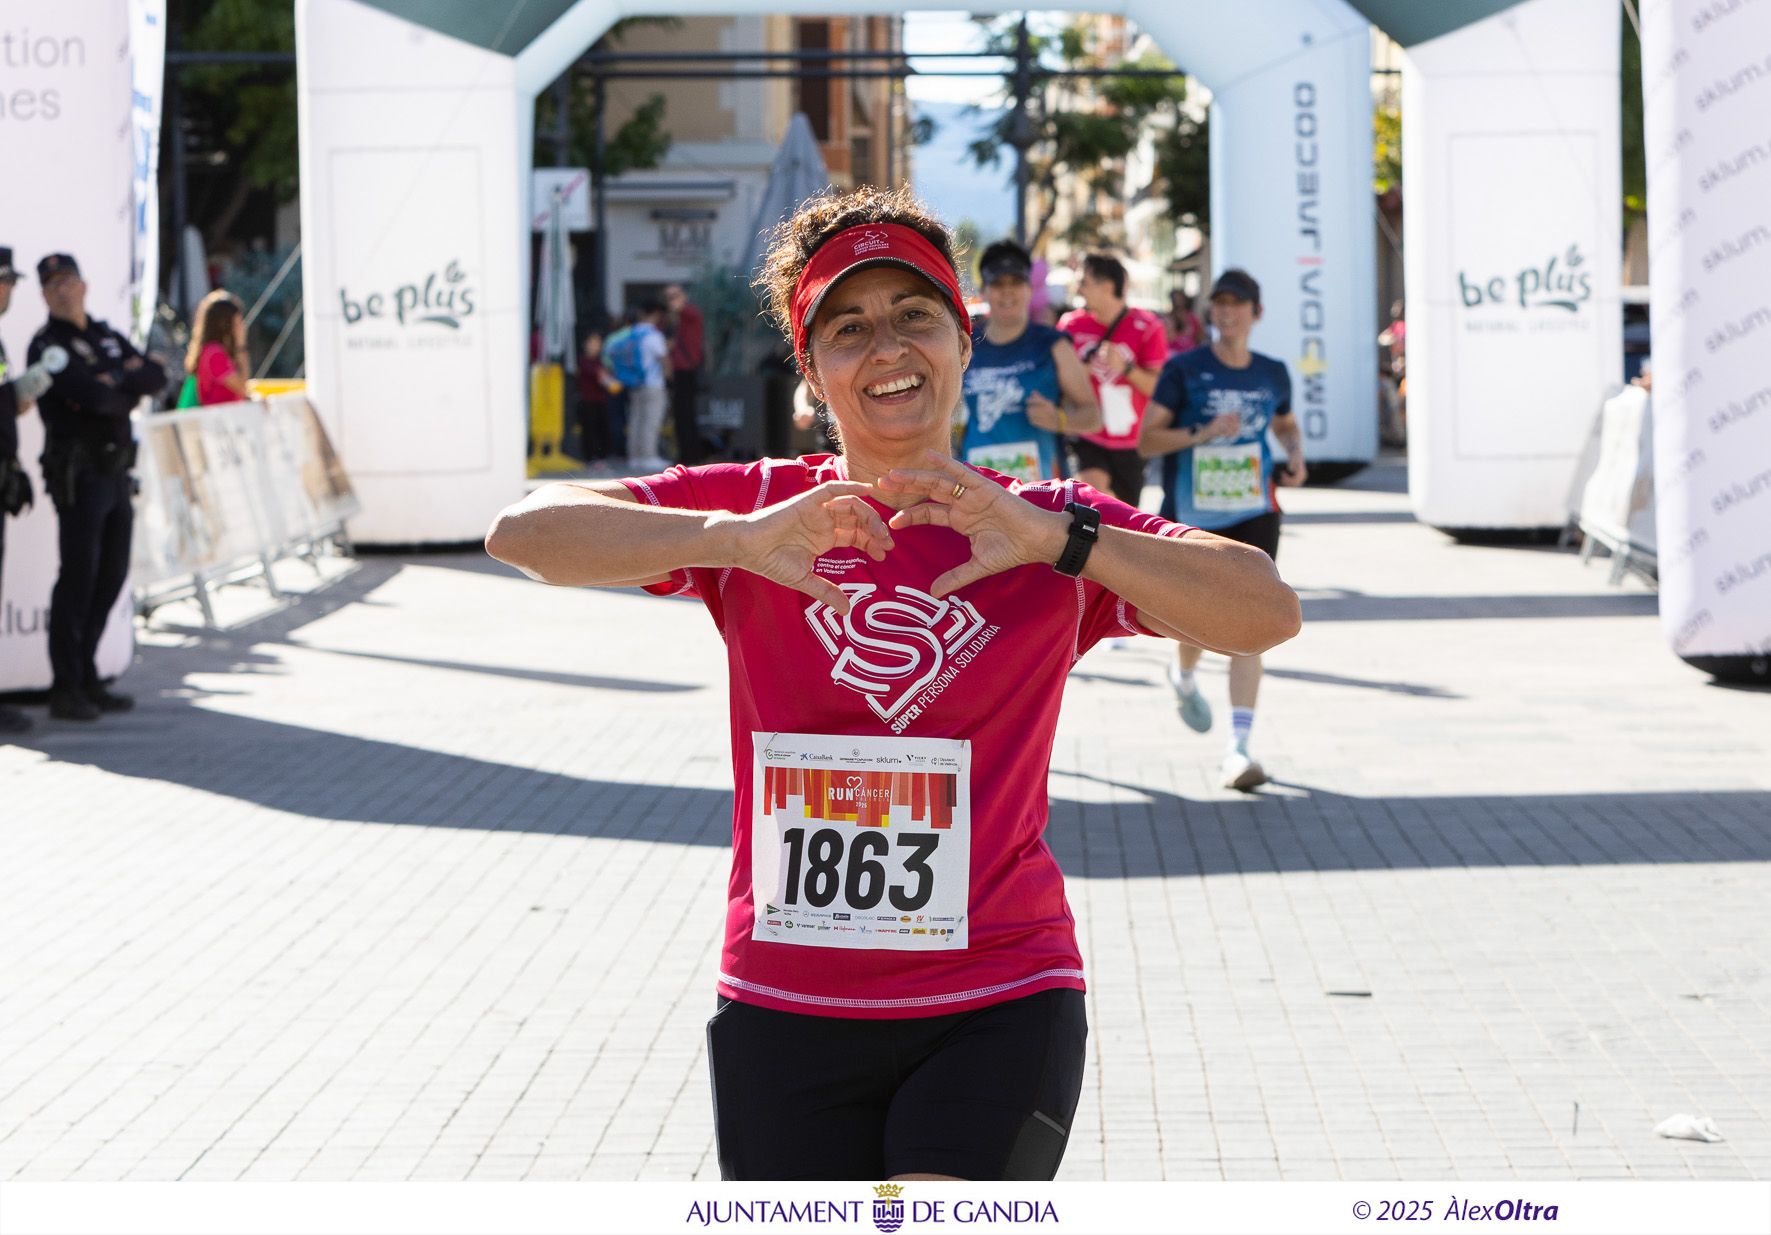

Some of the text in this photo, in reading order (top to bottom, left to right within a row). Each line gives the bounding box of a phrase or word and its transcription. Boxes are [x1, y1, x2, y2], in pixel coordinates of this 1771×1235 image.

[0, 88, 61, 121] es
[339, 272, 475, 325] be plus
[1458, 255, 1591, 308] be plus
[6, 598, 50, 637] lu
[890, 624, 1001, 735] SÚPER PERSONA SOLIDARIA
[828, 787, 854, 801] RUN
[783, 827, 940, 912] 1863
